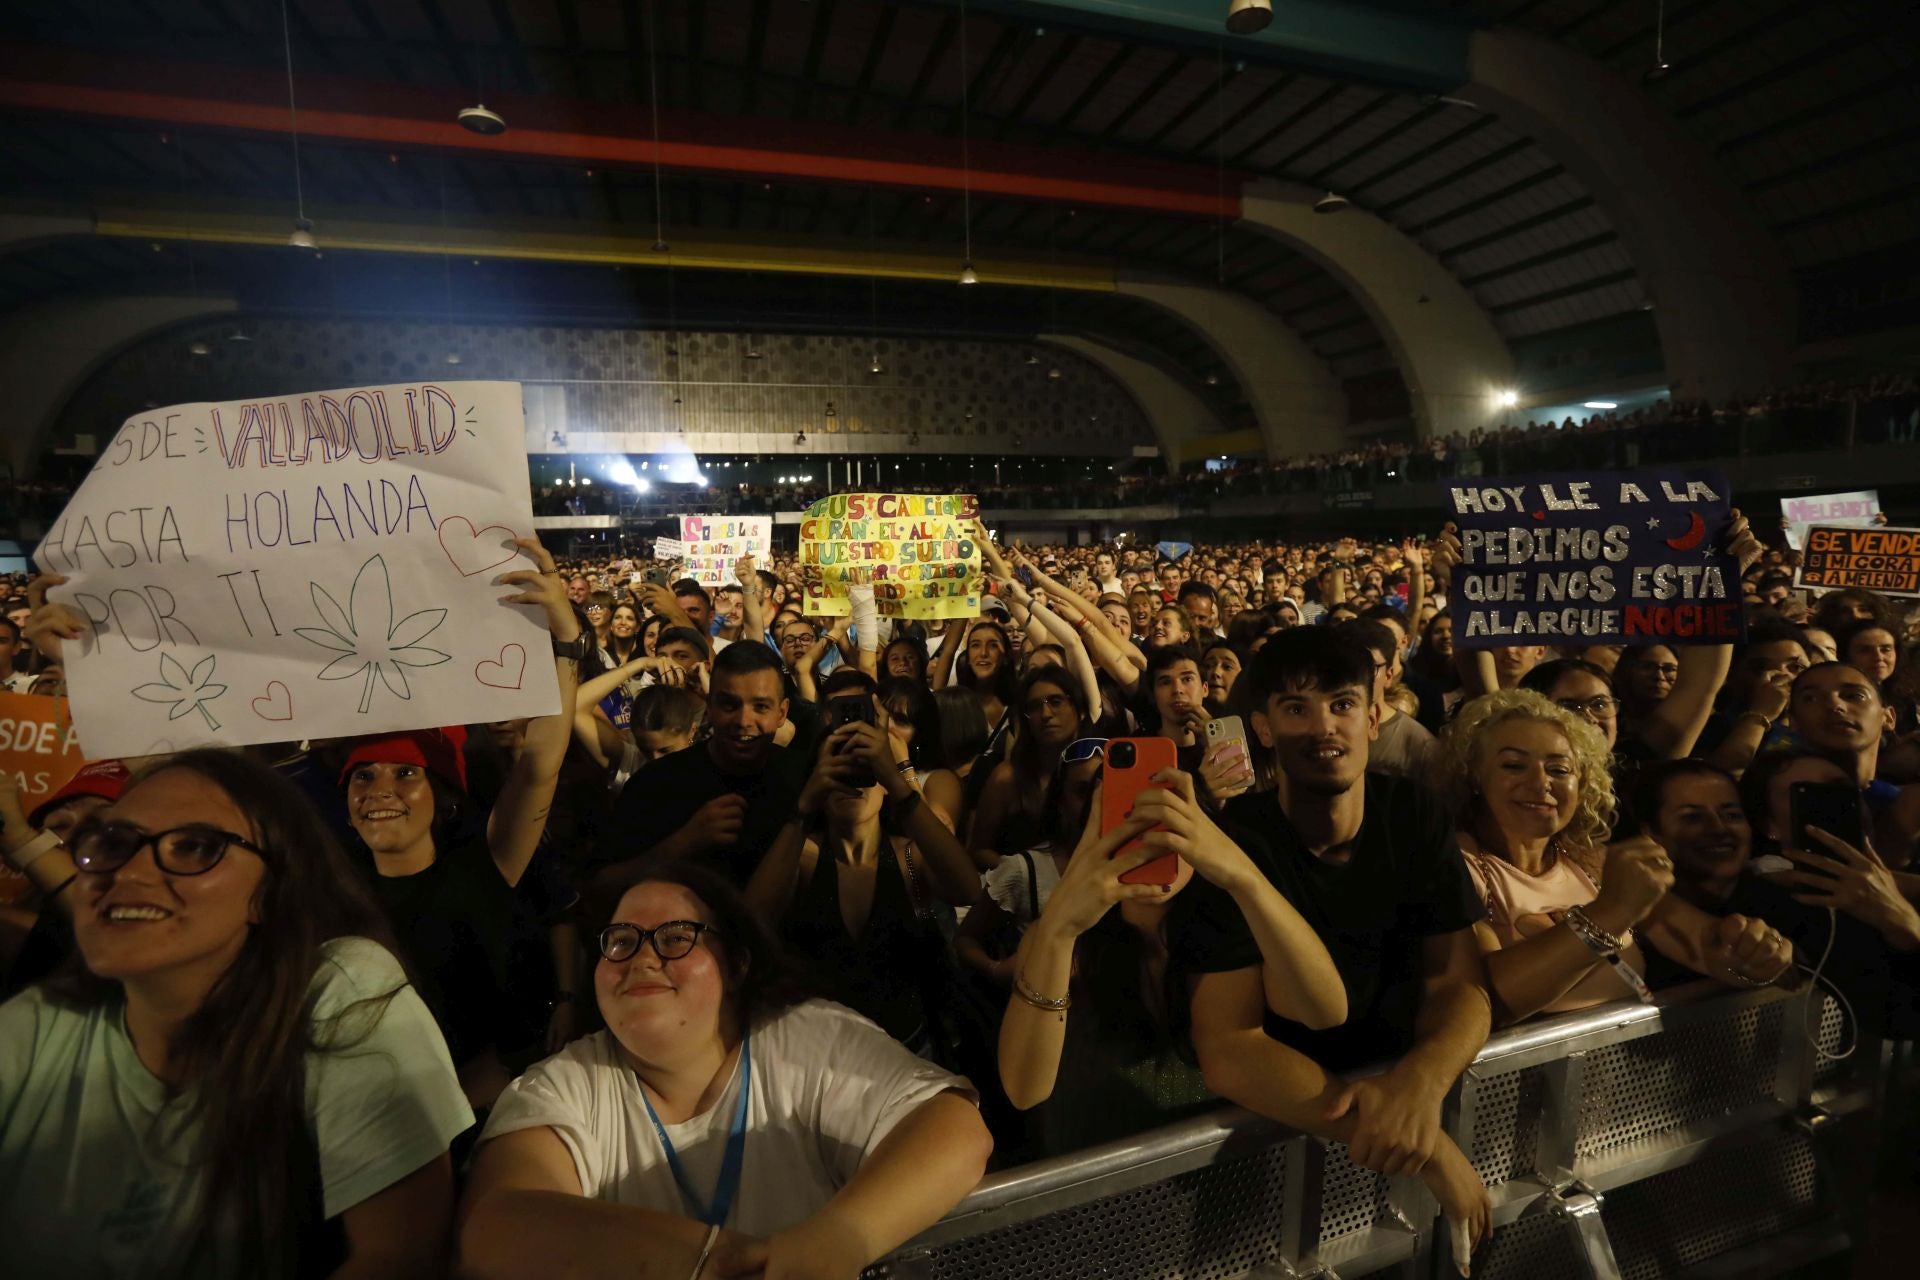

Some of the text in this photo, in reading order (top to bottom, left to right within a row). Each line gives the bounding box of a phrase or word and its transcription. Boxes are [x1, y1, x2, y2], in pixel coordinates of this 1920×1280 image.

[94, 385, 457, 472] SDE VALLADOLID
[805, 495, 864, 519] TUS
[1451, 481, 1721, 514] HOY LE A LA
[42, 474, 437, 571] HASTA HOLANDA
[801, 519, 957, 540] CURAN EL ALMA
[805, 541, 895, 565] NUESTRO
[1462, 525, 1631, 565] PEDIMOS
[1810, 531, 1847, 552] SE
[1831, 554, 1850, 568] MI
[825, 564, 888, 584] CANTAR
[1464, 564, 1727, 603] QUE NOS ESTA
[1828, 571, 1912, 588] A MELENDI
[948, 582, 968, 597] LA
[74, 570, 283, 655] POR TI
[1465, 603, 1739, 638] ALARGUE NOCHE
